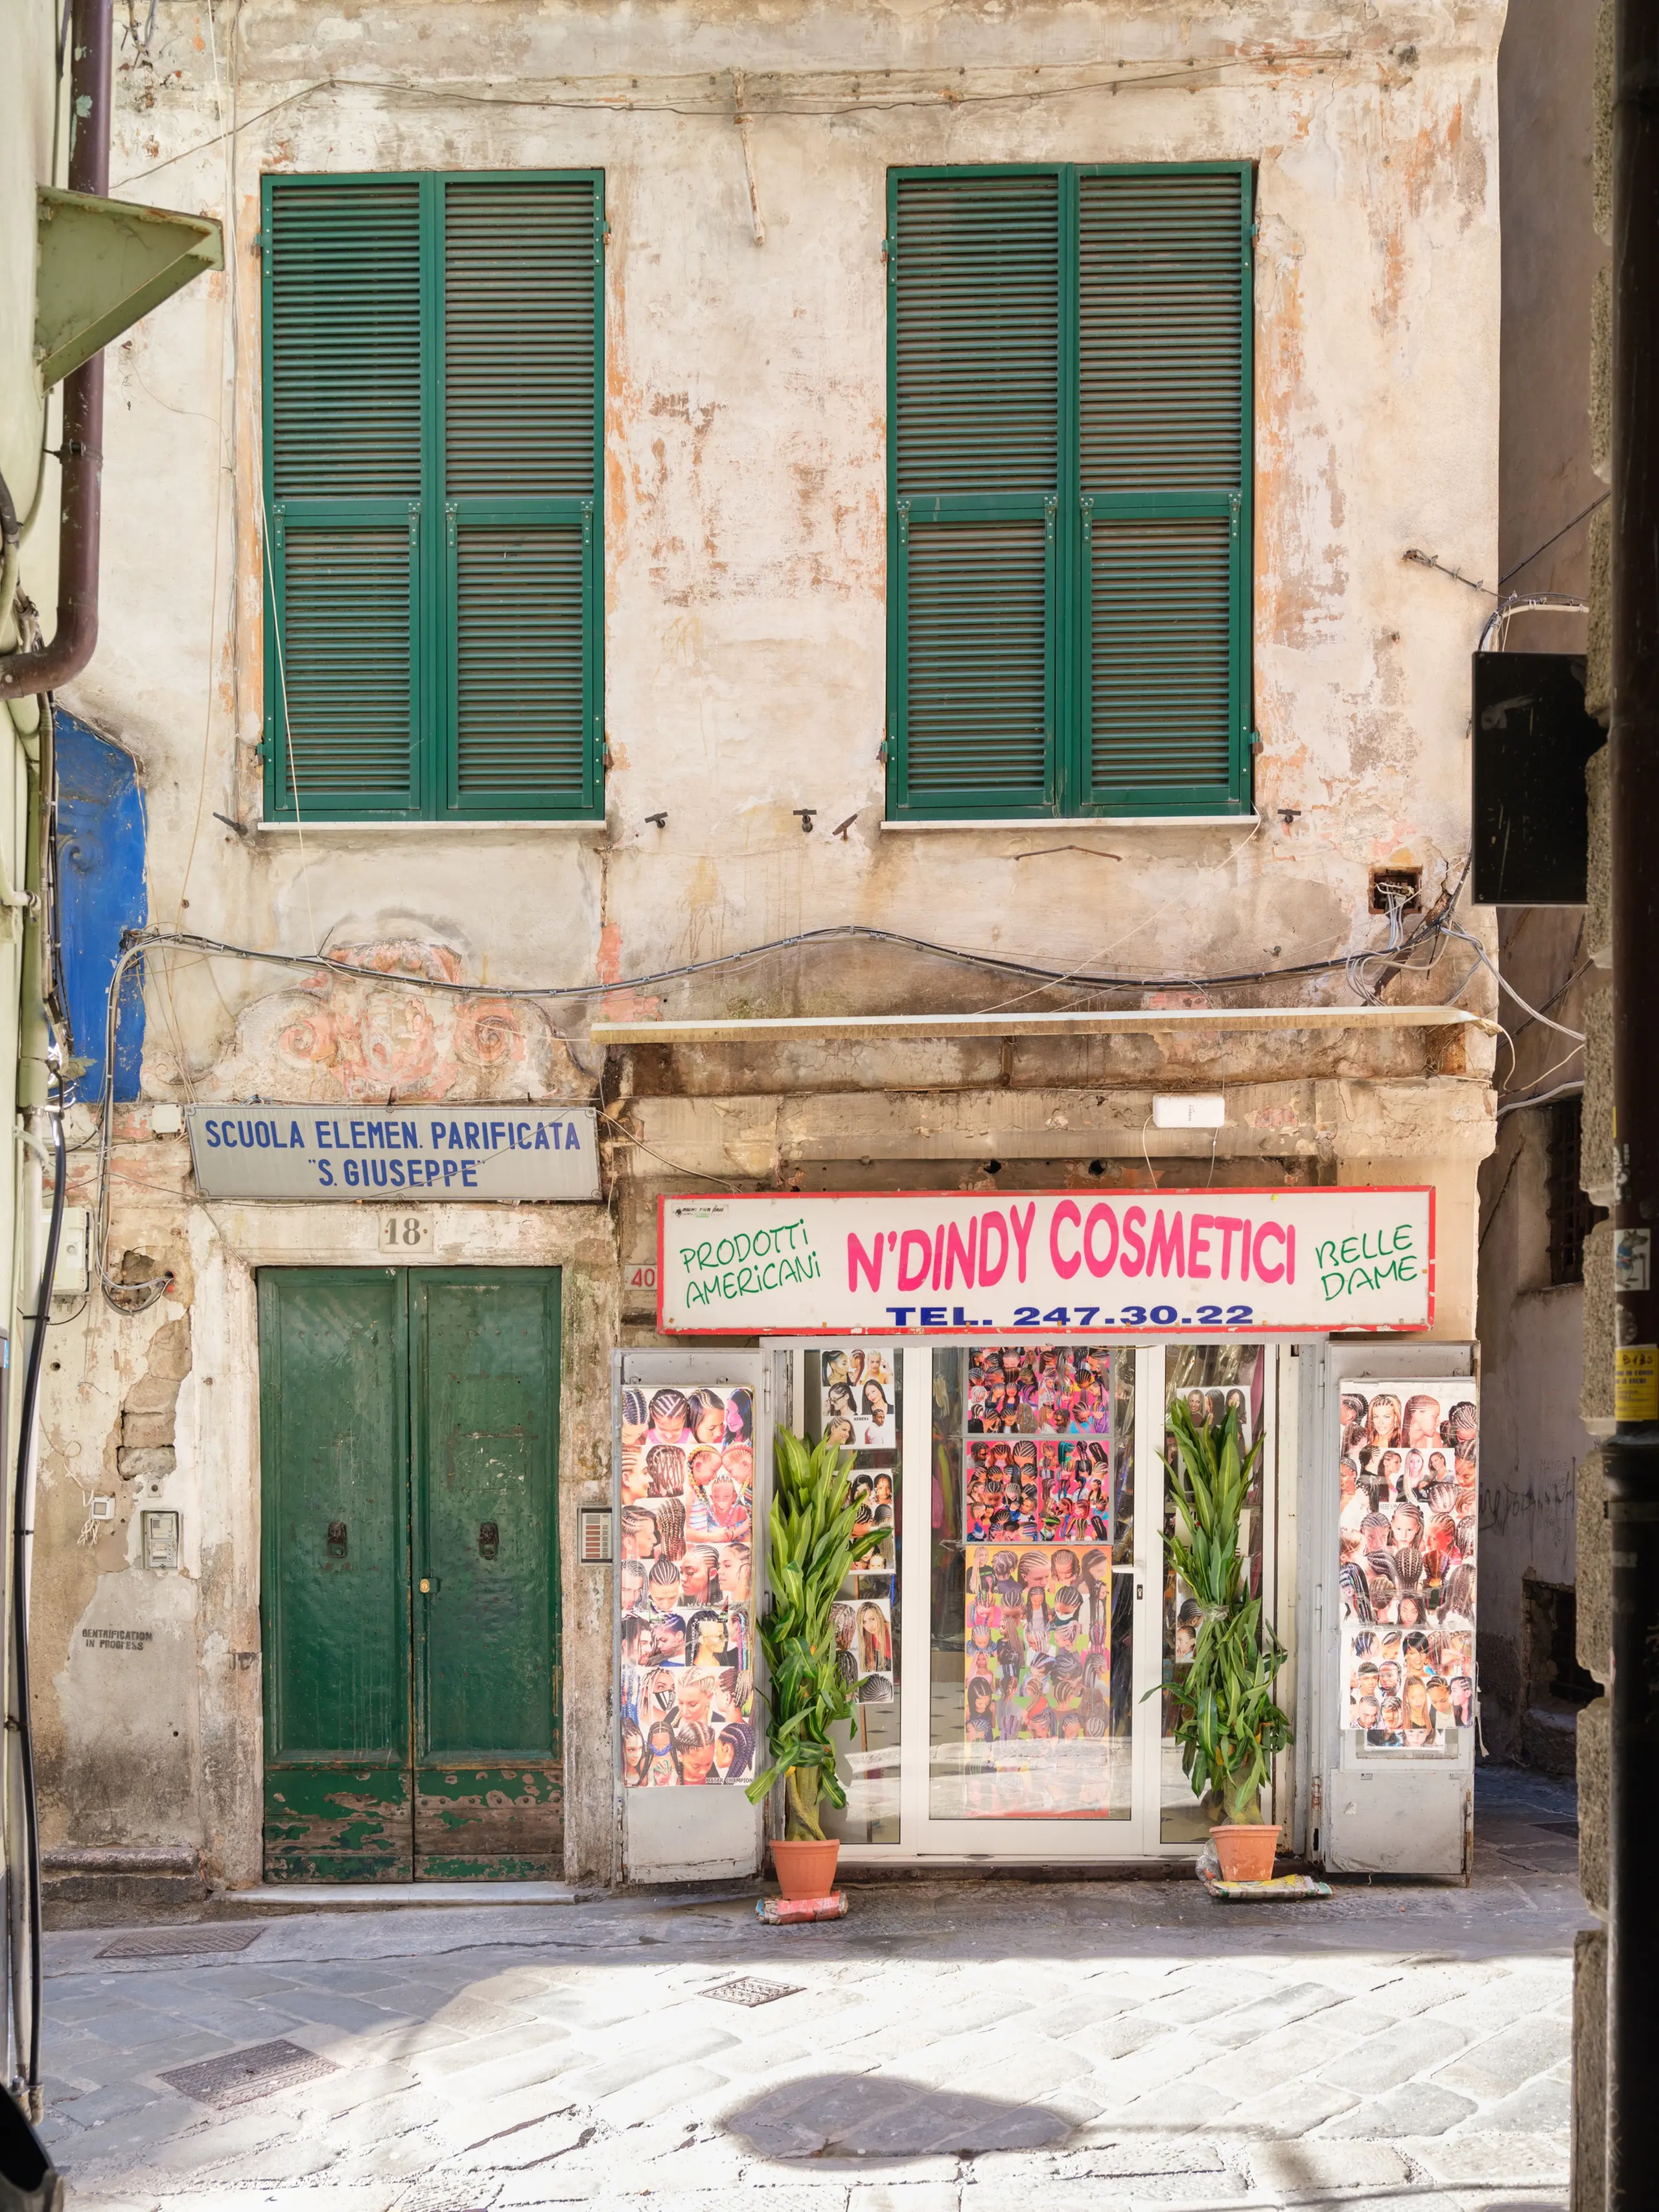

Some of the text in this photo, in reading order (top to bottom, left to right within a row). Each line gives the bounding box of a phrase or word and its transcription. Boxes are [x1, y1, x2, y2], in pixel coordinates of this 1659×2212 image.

[206, 1120, 581, 1150] SCUOLA ELEMEN. PARIFICATA
[385, 1217, 421, 1246] 18
[847, 1199, 1296, 1293] N'DINDY COSMETICI
[1316, 1224, 1413, 1269] BELLE
[631, 1267, 655, 1287] 40
[1321, 1255, 1418, 1301] DAME
[886, 1305, 1253, 1326] TEL. 247.30.22
[82, 1629, 152, 1641] GENTRIFICATION
[86, 1639, 144, 1651] IN PROGRESS
